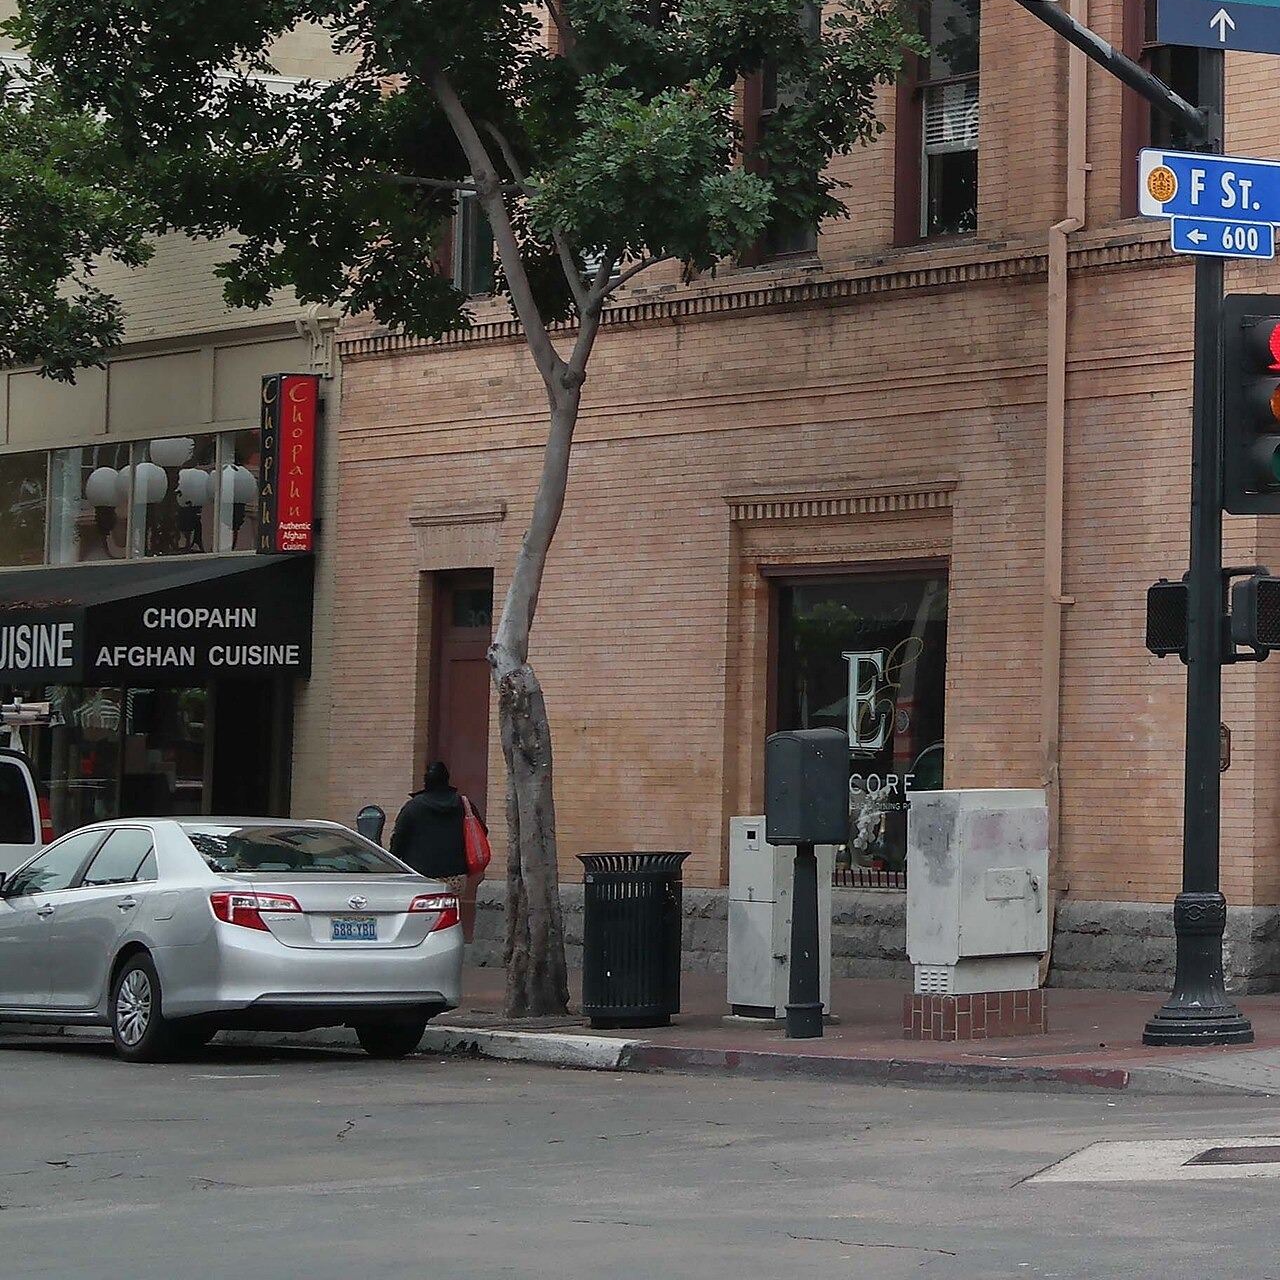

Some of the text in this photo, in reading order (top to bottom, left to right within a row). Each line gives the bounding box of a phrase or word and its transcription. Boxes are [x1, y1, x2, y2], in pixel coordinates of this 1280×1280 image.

[1191, 168, 1261, 211] F ST.
[1222, 226, 1259, 252] 600
[287, 382, 309, 517] Chopahn
[261, 377, 277, 549] Chopahn
[278, 521, 311, 531] Authentic
[282, 531, 307, 542] Afghan
[282, 542, 307, 551] Cuisine
[142, 607, 257, 629] CHOPAHN
[94, 644, 300, 667] AFGHAN CUISINE
[849, 772, 916, 795] CORE
